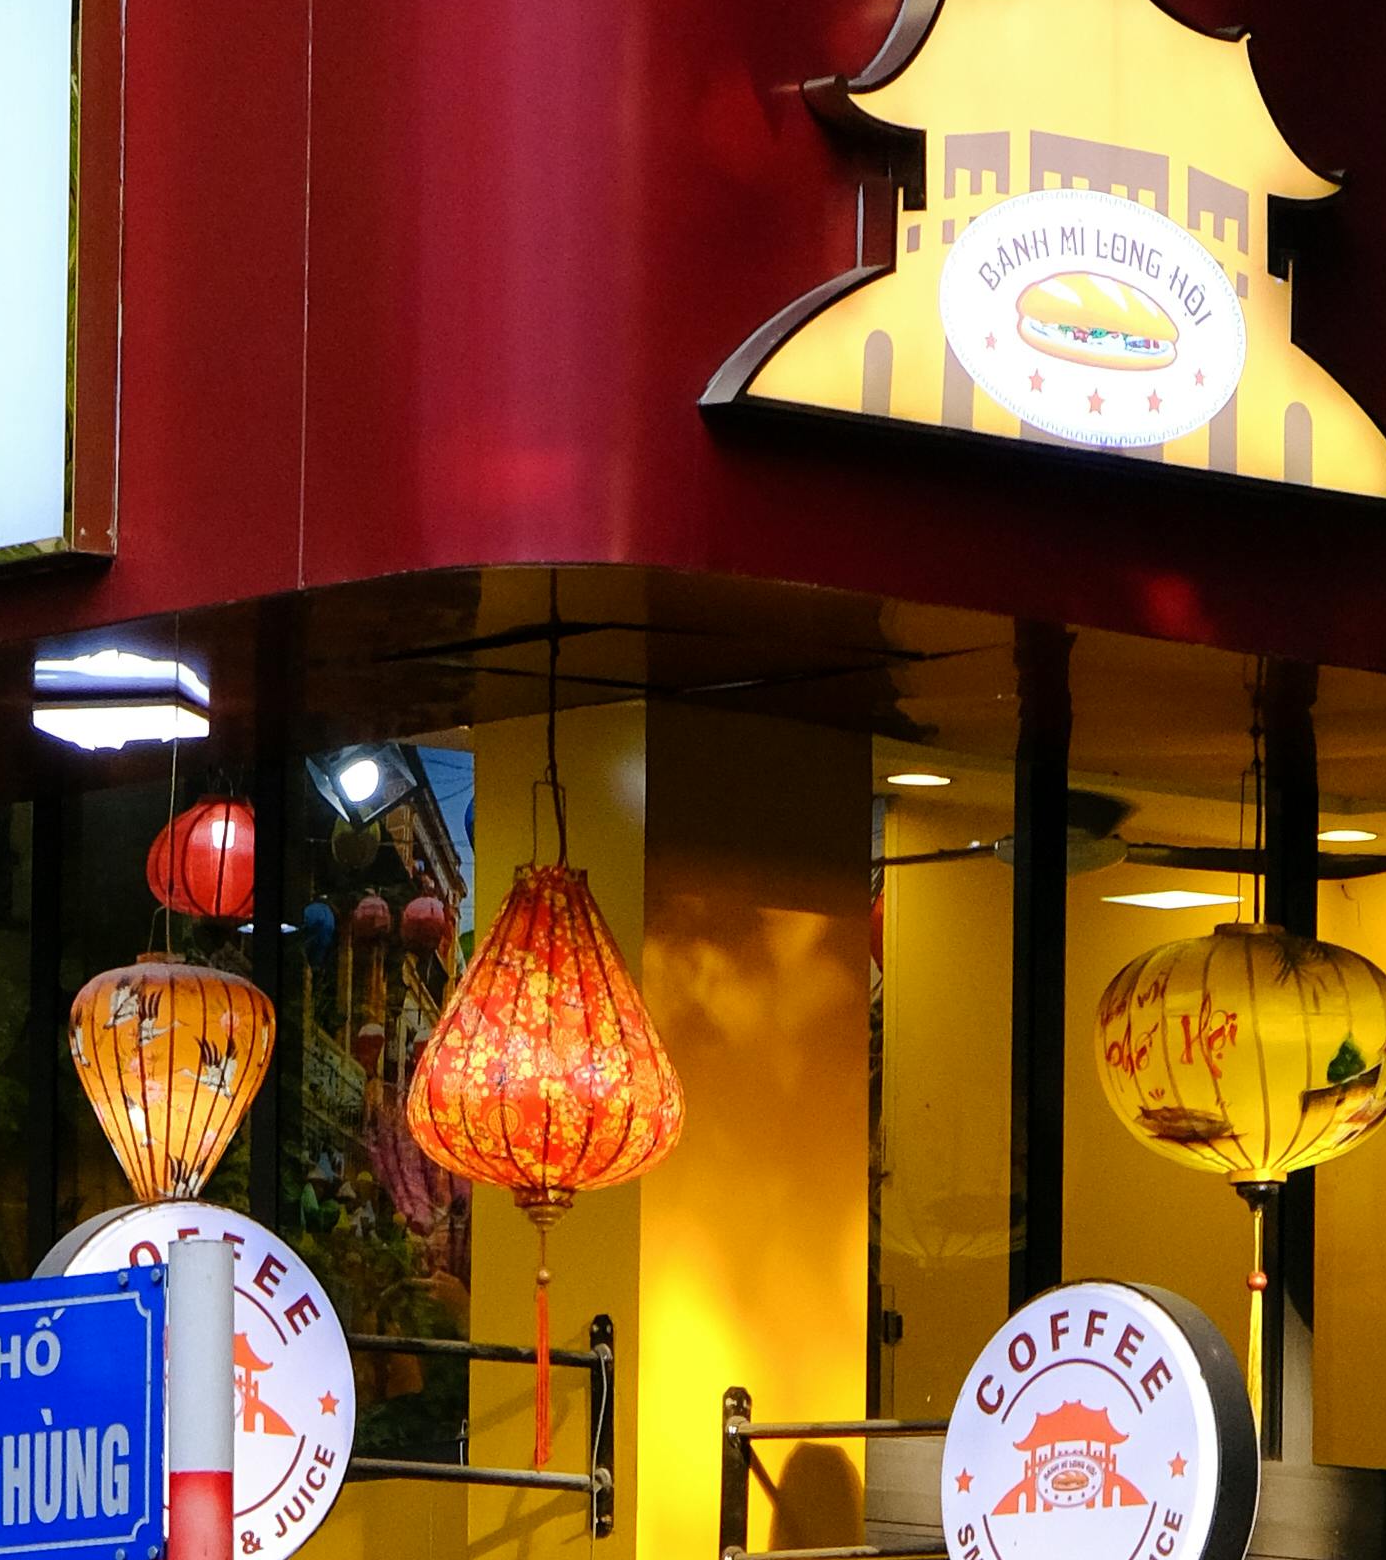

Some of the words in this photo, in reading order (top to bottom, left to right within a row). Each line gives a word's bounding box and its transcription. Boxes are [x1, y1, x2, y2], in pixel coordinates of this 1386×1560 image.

[979, 228, 1049, 290] BÁNH
[1097, 230, 1162, 279] LONG
[976, 1309, 1173, 1416] COFFEE
[241, 1530, 263, 1554] &
[275, 1444, 336, 1537] JUICE
